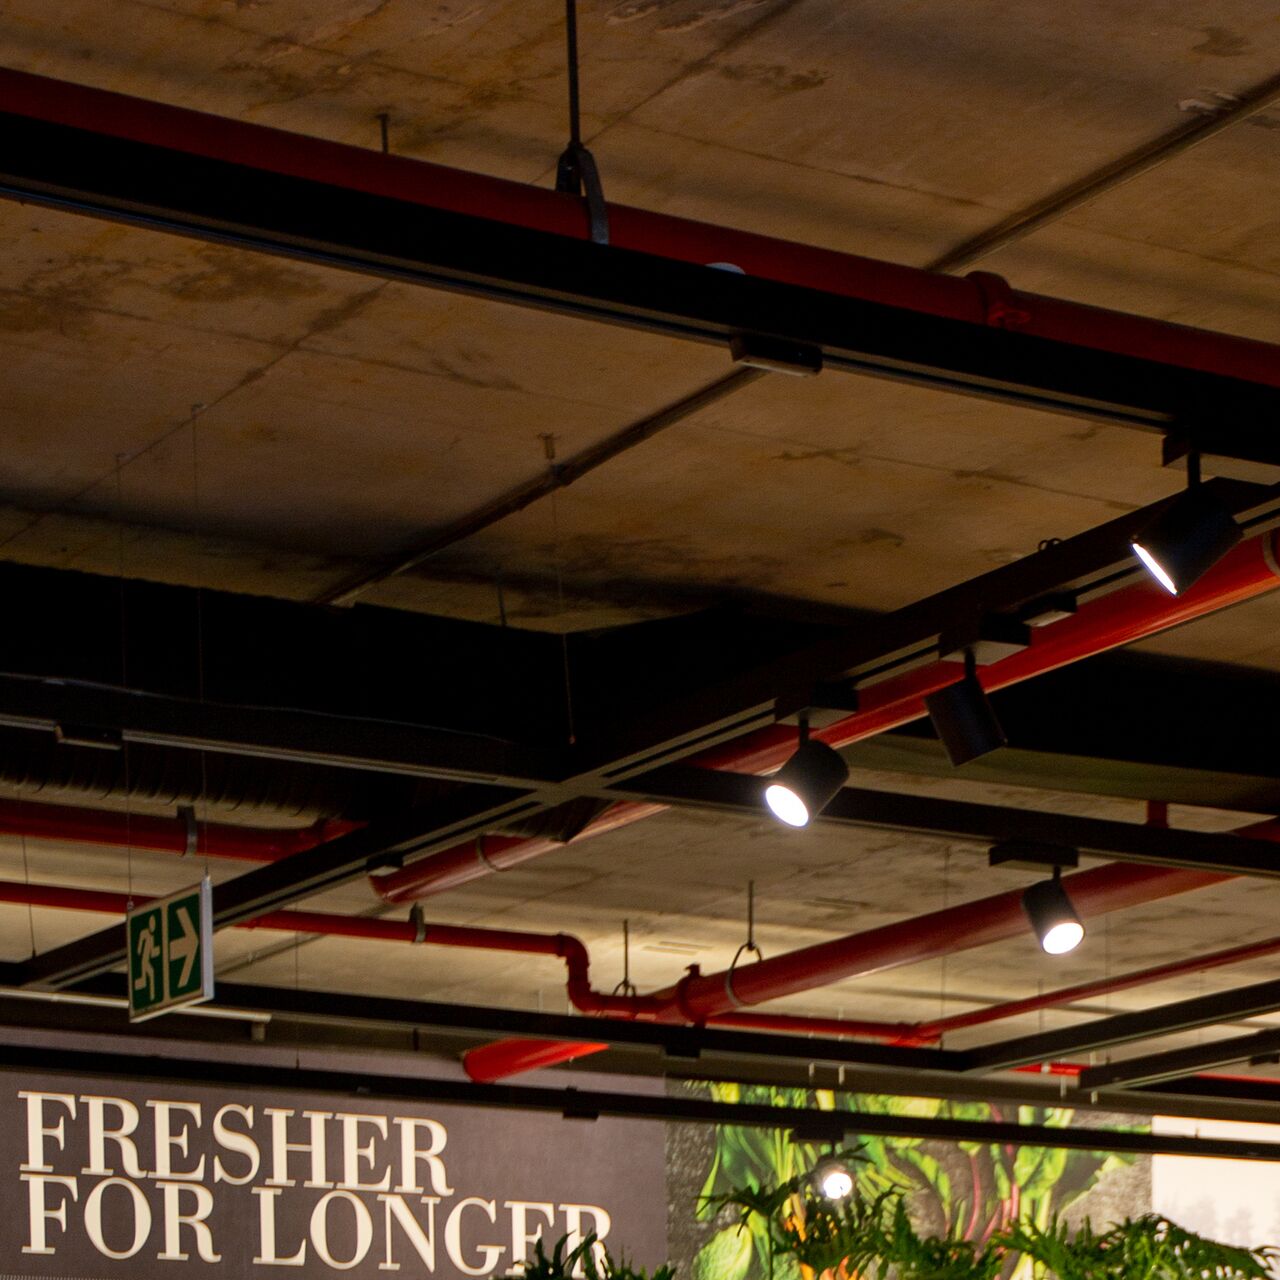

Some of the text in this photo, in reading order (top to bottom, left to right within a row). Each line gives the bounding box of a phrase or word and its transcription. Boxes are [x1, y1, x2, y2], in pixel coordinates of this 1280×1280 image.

[18, 1090, 454, 1197] FRESHER
[20, 1172, 613, 1280] FOR LONGER
